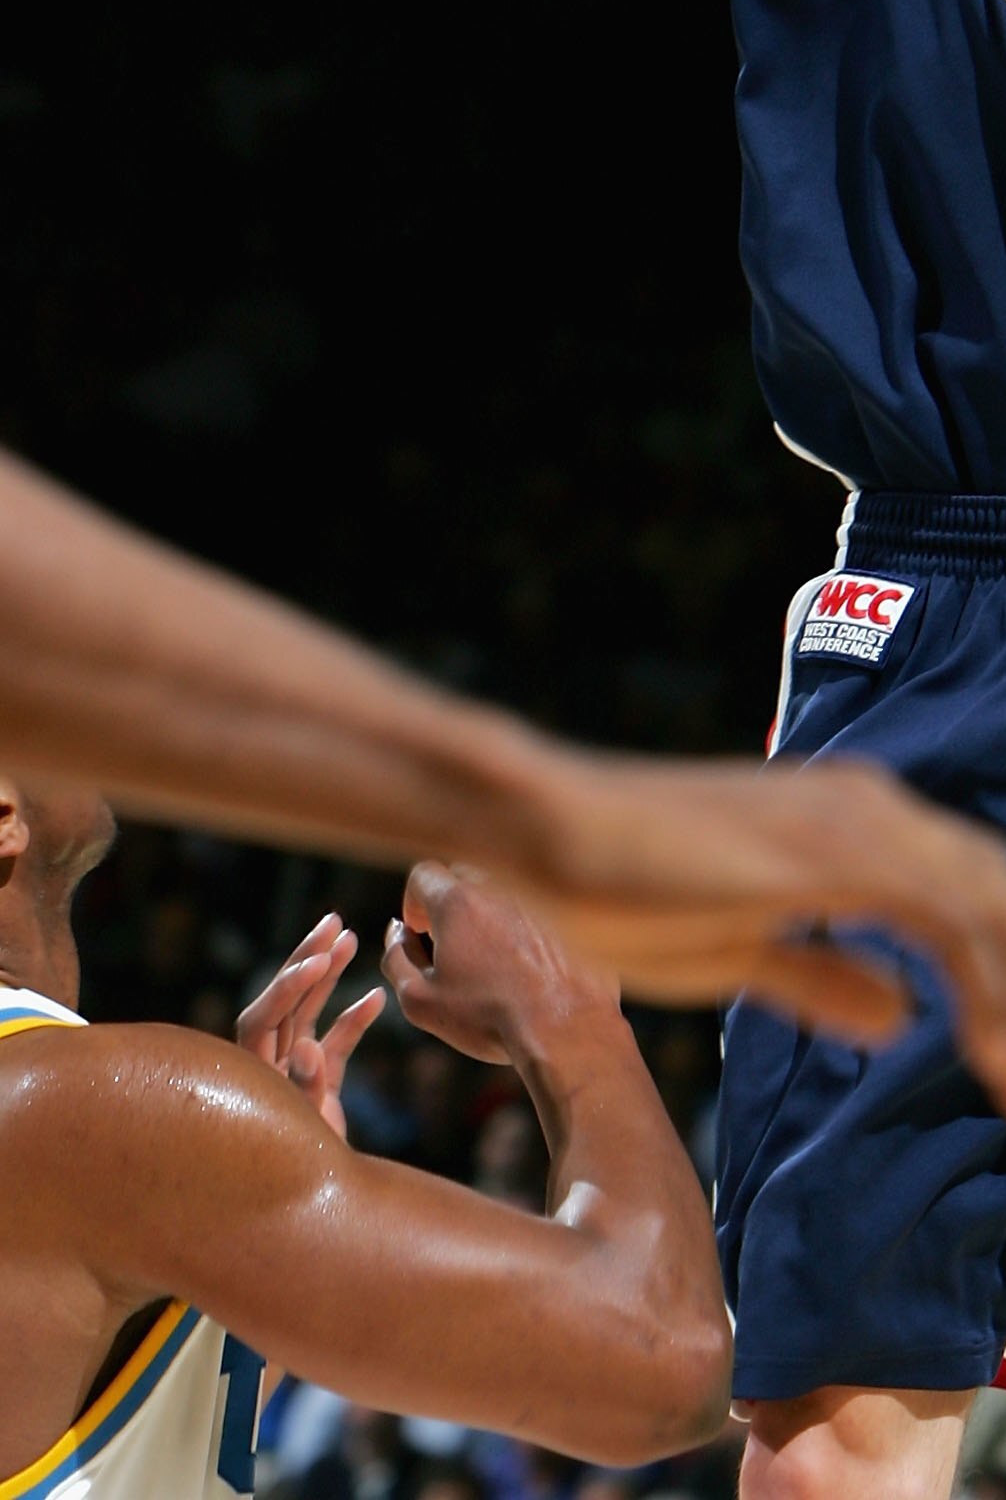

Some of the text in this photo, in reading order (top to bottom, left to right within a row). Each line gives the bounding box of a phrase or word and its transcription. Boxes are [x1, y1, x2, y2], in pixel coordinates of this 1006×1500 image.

[817, 580, 904, 626] WCC
[803, 622, 890, 647] WEST COAST
[799, 637, 884, 662] CONFERENCE
